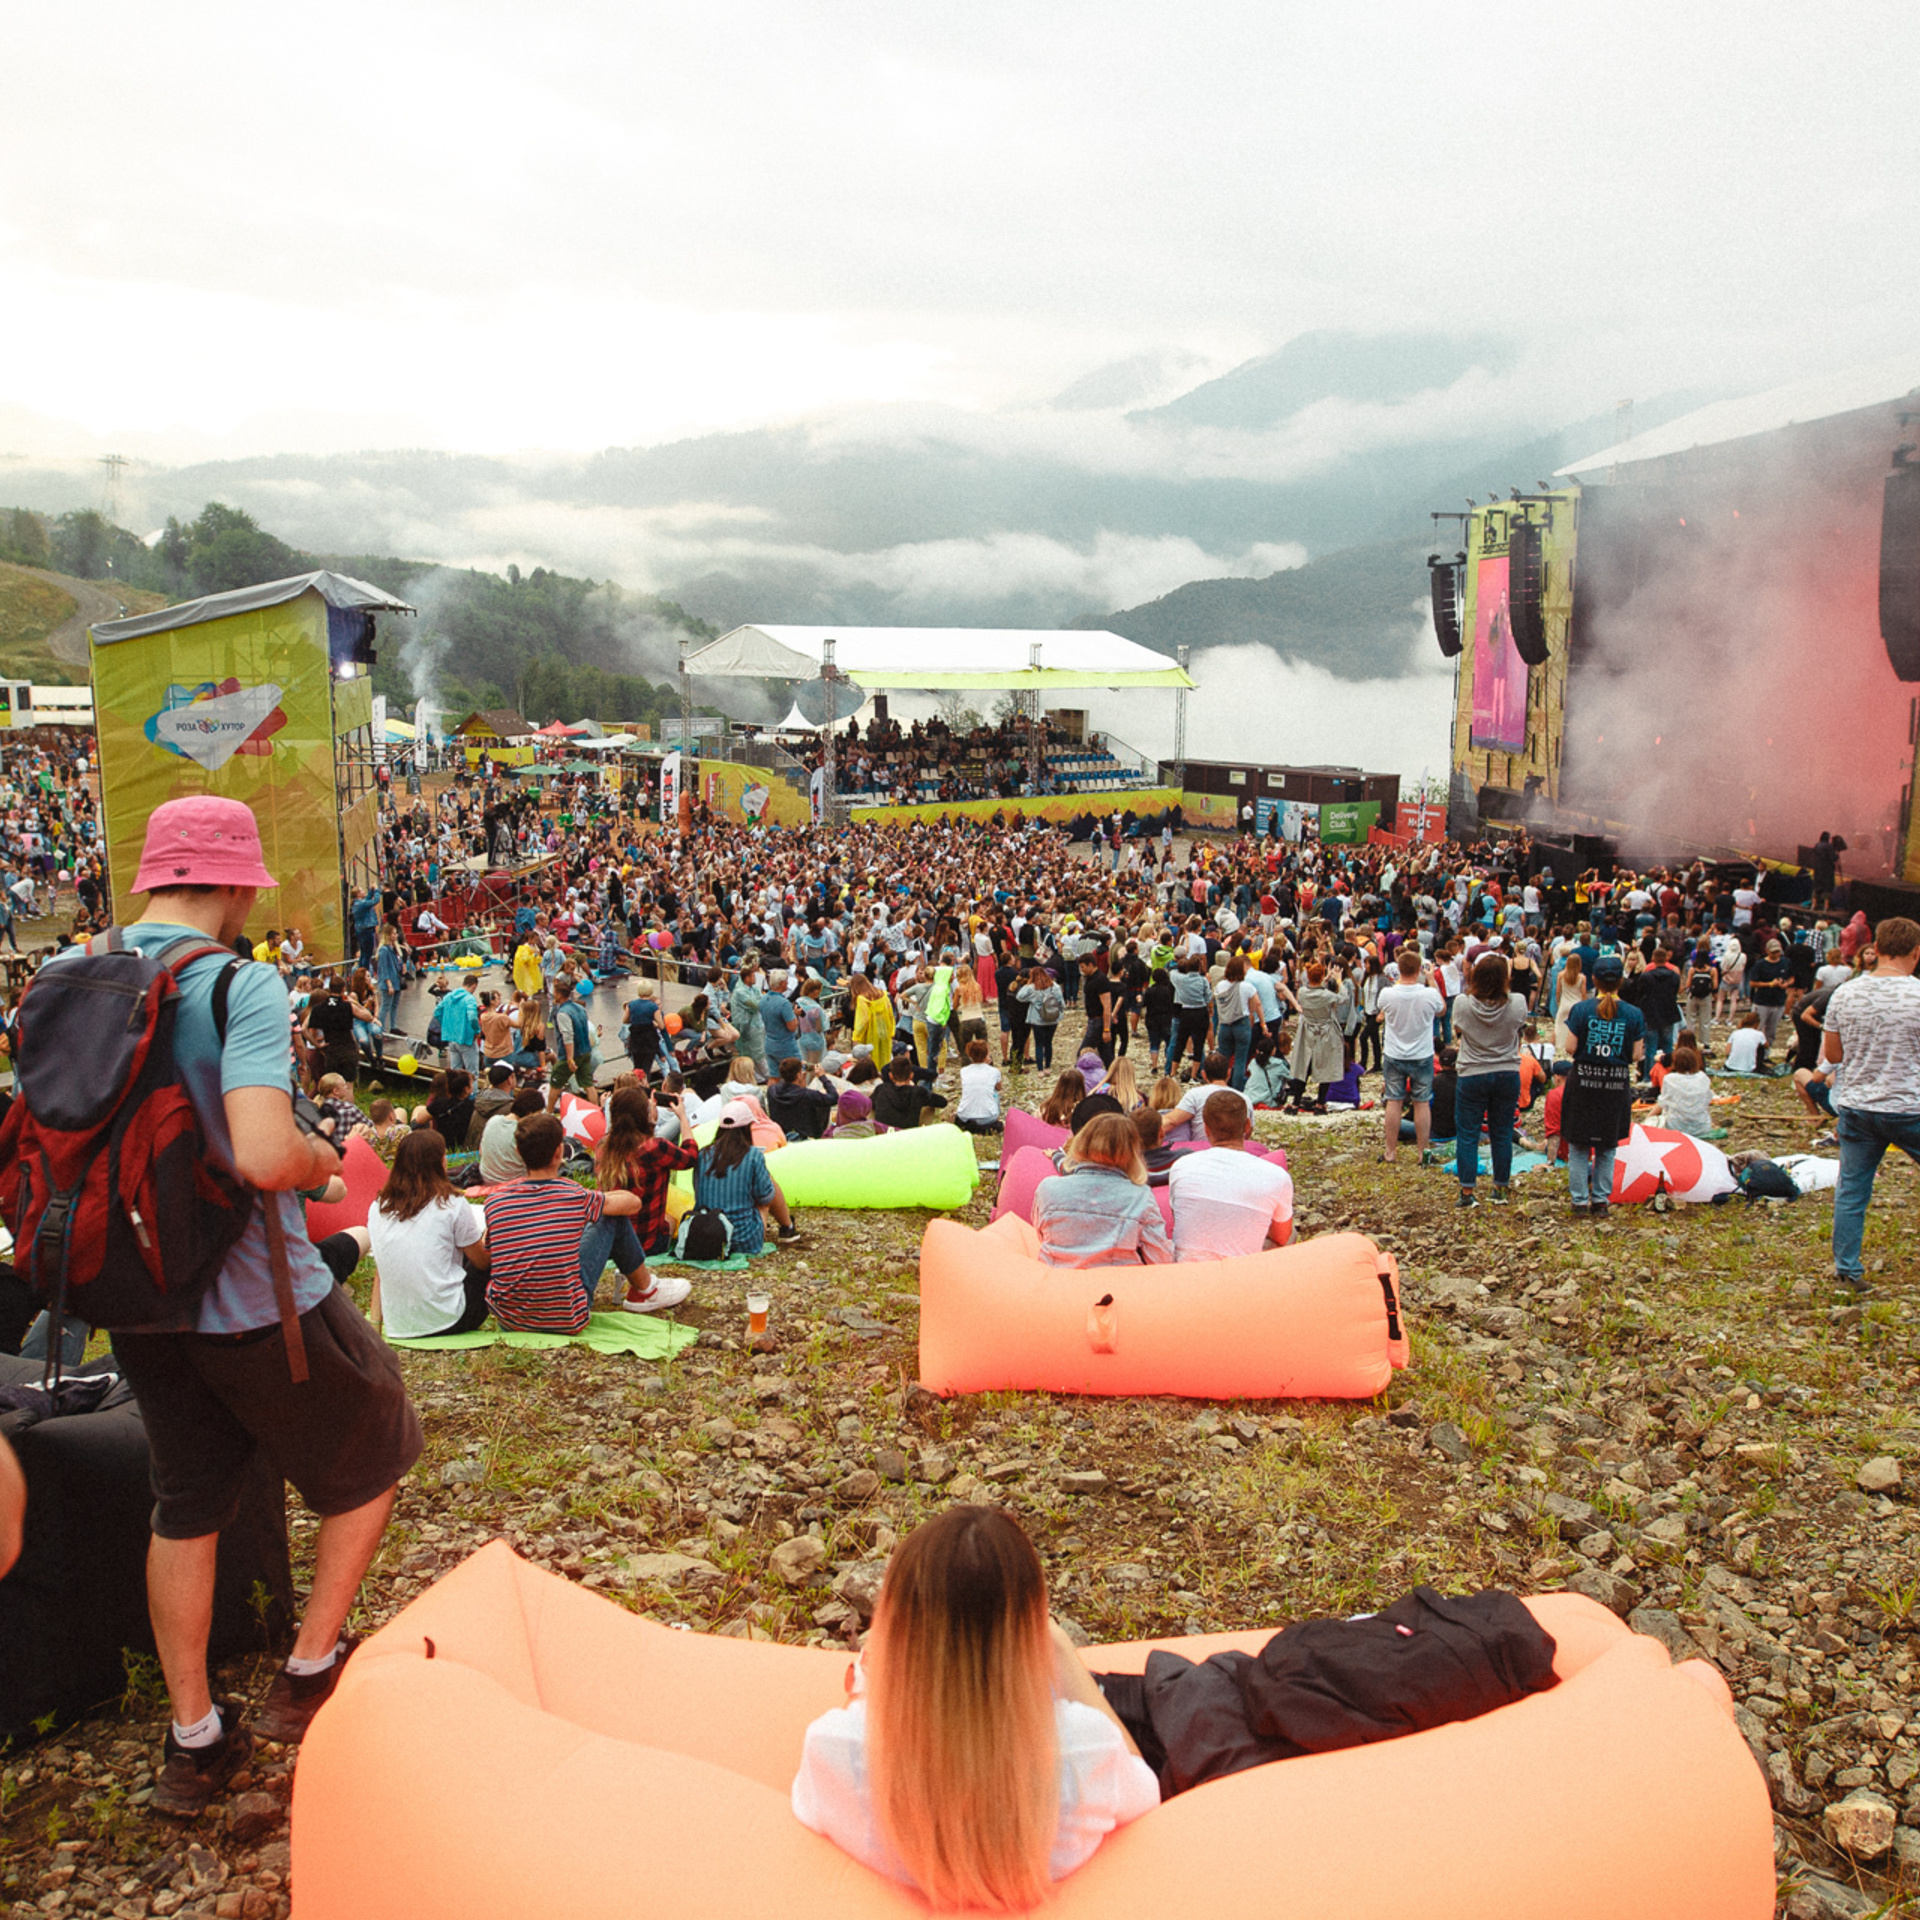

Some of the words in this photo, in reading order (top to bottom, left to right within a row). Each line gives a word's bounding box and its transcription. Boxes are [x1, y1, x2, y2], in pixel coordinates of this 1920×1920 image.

[176, 722, 198, 731] РОЗА
[221, 723, 246, 731] ХУТОР
[1330, 811, 1358, 820] Delivery
[1329, 820, 1347, 828] Club
[1588, 1018, 1626, 1035] CELE
